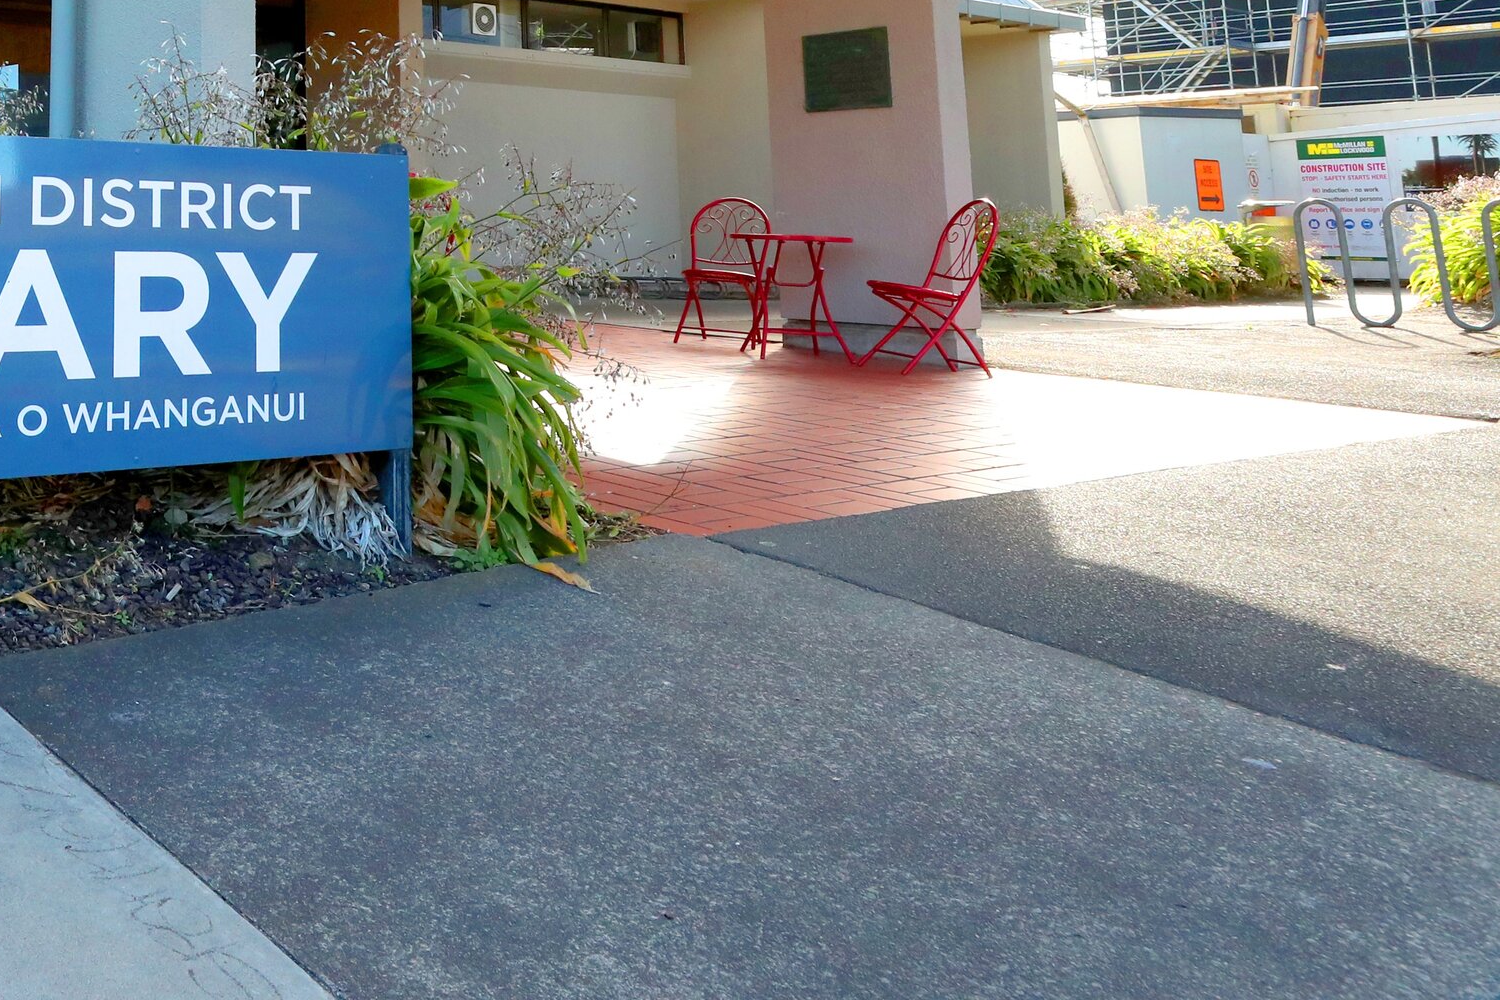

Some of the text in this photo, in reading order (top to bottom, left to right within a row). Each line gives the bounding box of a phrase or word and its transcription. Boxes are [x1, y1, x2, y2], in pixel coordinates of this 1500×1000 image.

[1300, 162, 1386, 173] CONSTRUCTION SITE
[31, 176, 312, 231] DISTRICT
[17, 404, 48, 437] O
[62, 392, 306, 434] WHANGANUI
